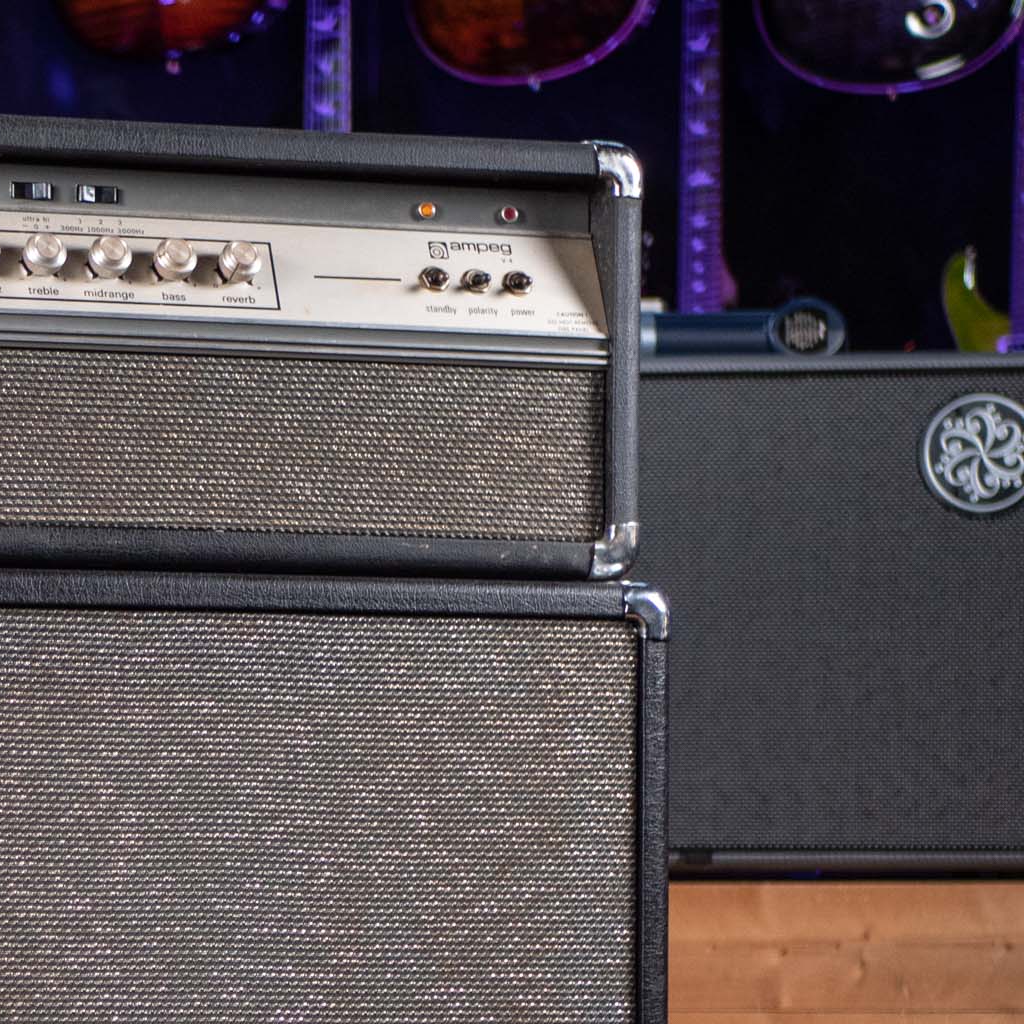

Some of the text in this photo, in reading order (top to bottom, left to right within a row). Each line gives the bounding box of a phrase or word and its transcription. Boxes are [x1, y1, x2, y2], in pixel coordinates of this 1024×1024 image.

[450, 241, 513, 256] ampeg
[28, 286, 60, 296] treble
[83, 287, 135, 300] midrange
[161, 291, 186, 302] bass
[222, 295, 256, 304] reverb
[425, 304, 457, 315] standby
[468, 305, 498, 317] polarity
[510, 308, 535, 317] power
